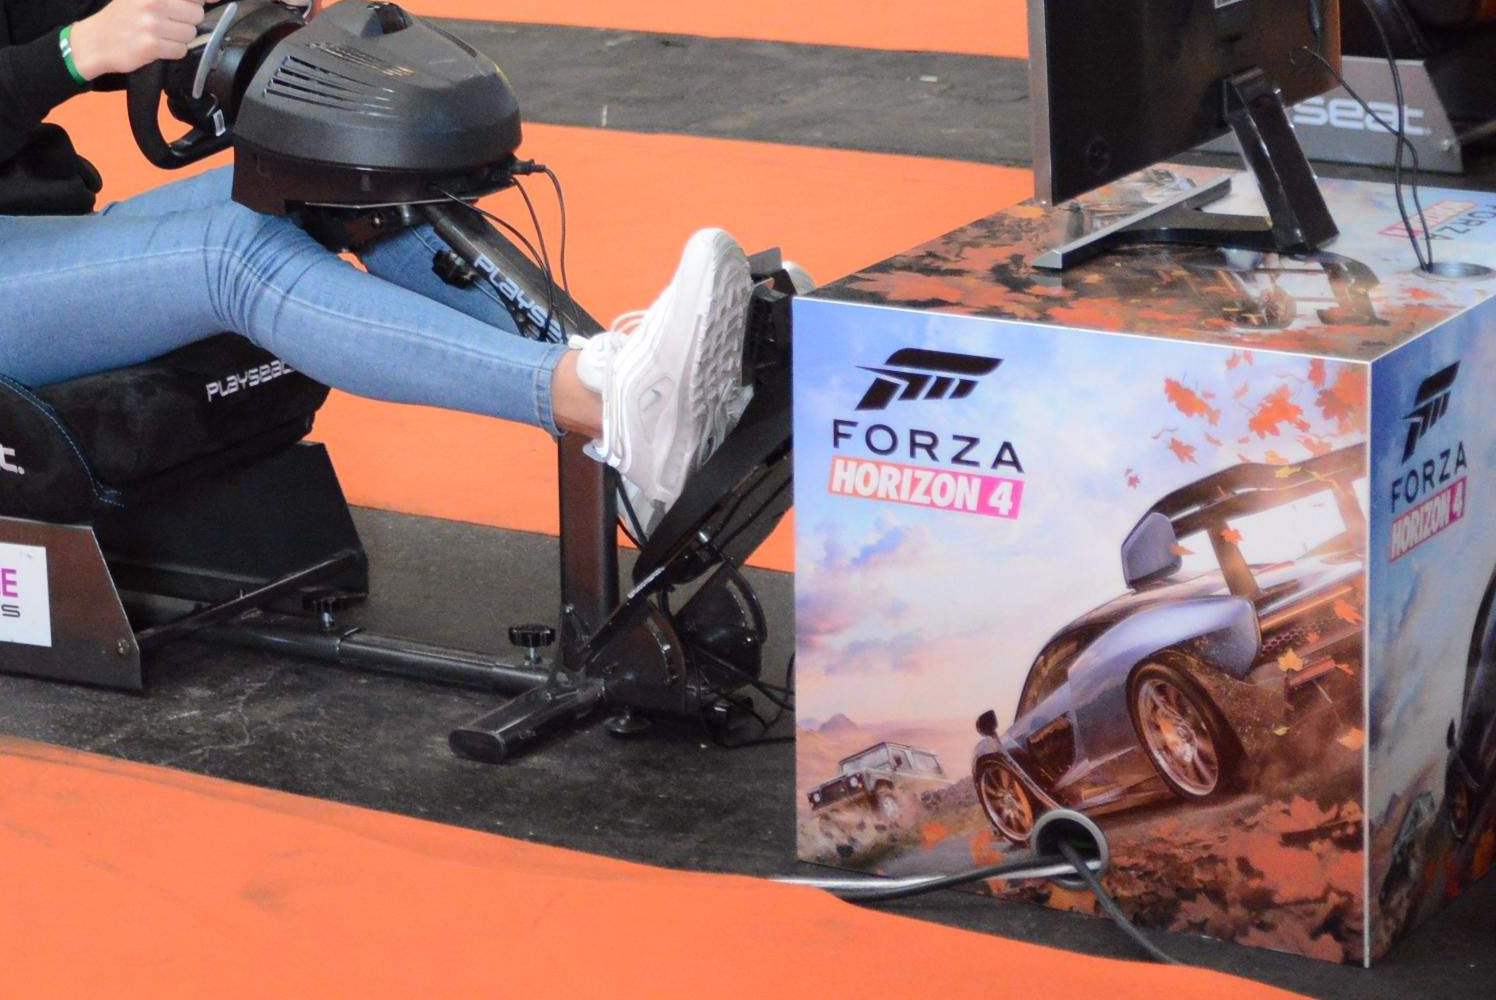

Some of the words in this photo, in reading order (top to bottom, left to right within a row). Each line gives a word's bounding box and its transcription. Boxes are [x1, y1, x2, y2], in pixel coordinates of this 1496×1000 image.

[832, 418, 1025, 474] FORZA
[831, 458, 982, 512] HORIZON
[988, 480, 1014, 516] 4
[1391, 440, 1468, 514] FORZA
